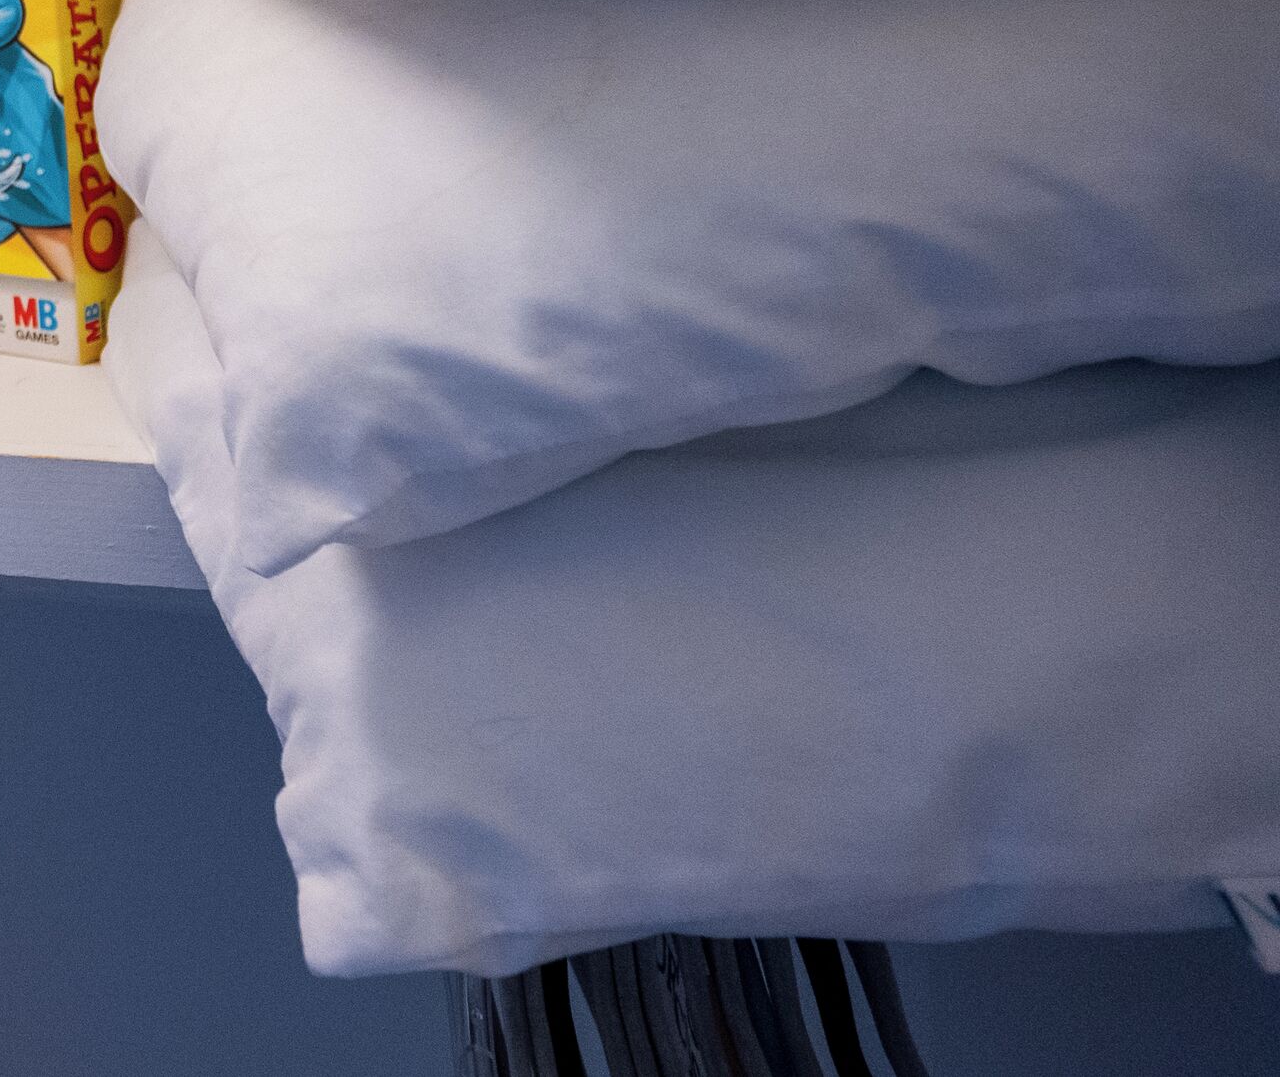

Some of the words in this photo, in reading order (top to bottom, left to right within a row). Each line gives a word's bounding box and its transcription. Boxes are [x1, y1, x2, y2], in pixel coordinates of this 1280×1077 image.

[12, 295, 59, 332] MB
[84, 301, 101, 345] MB
[15, 328, 60, 347] GAMES
